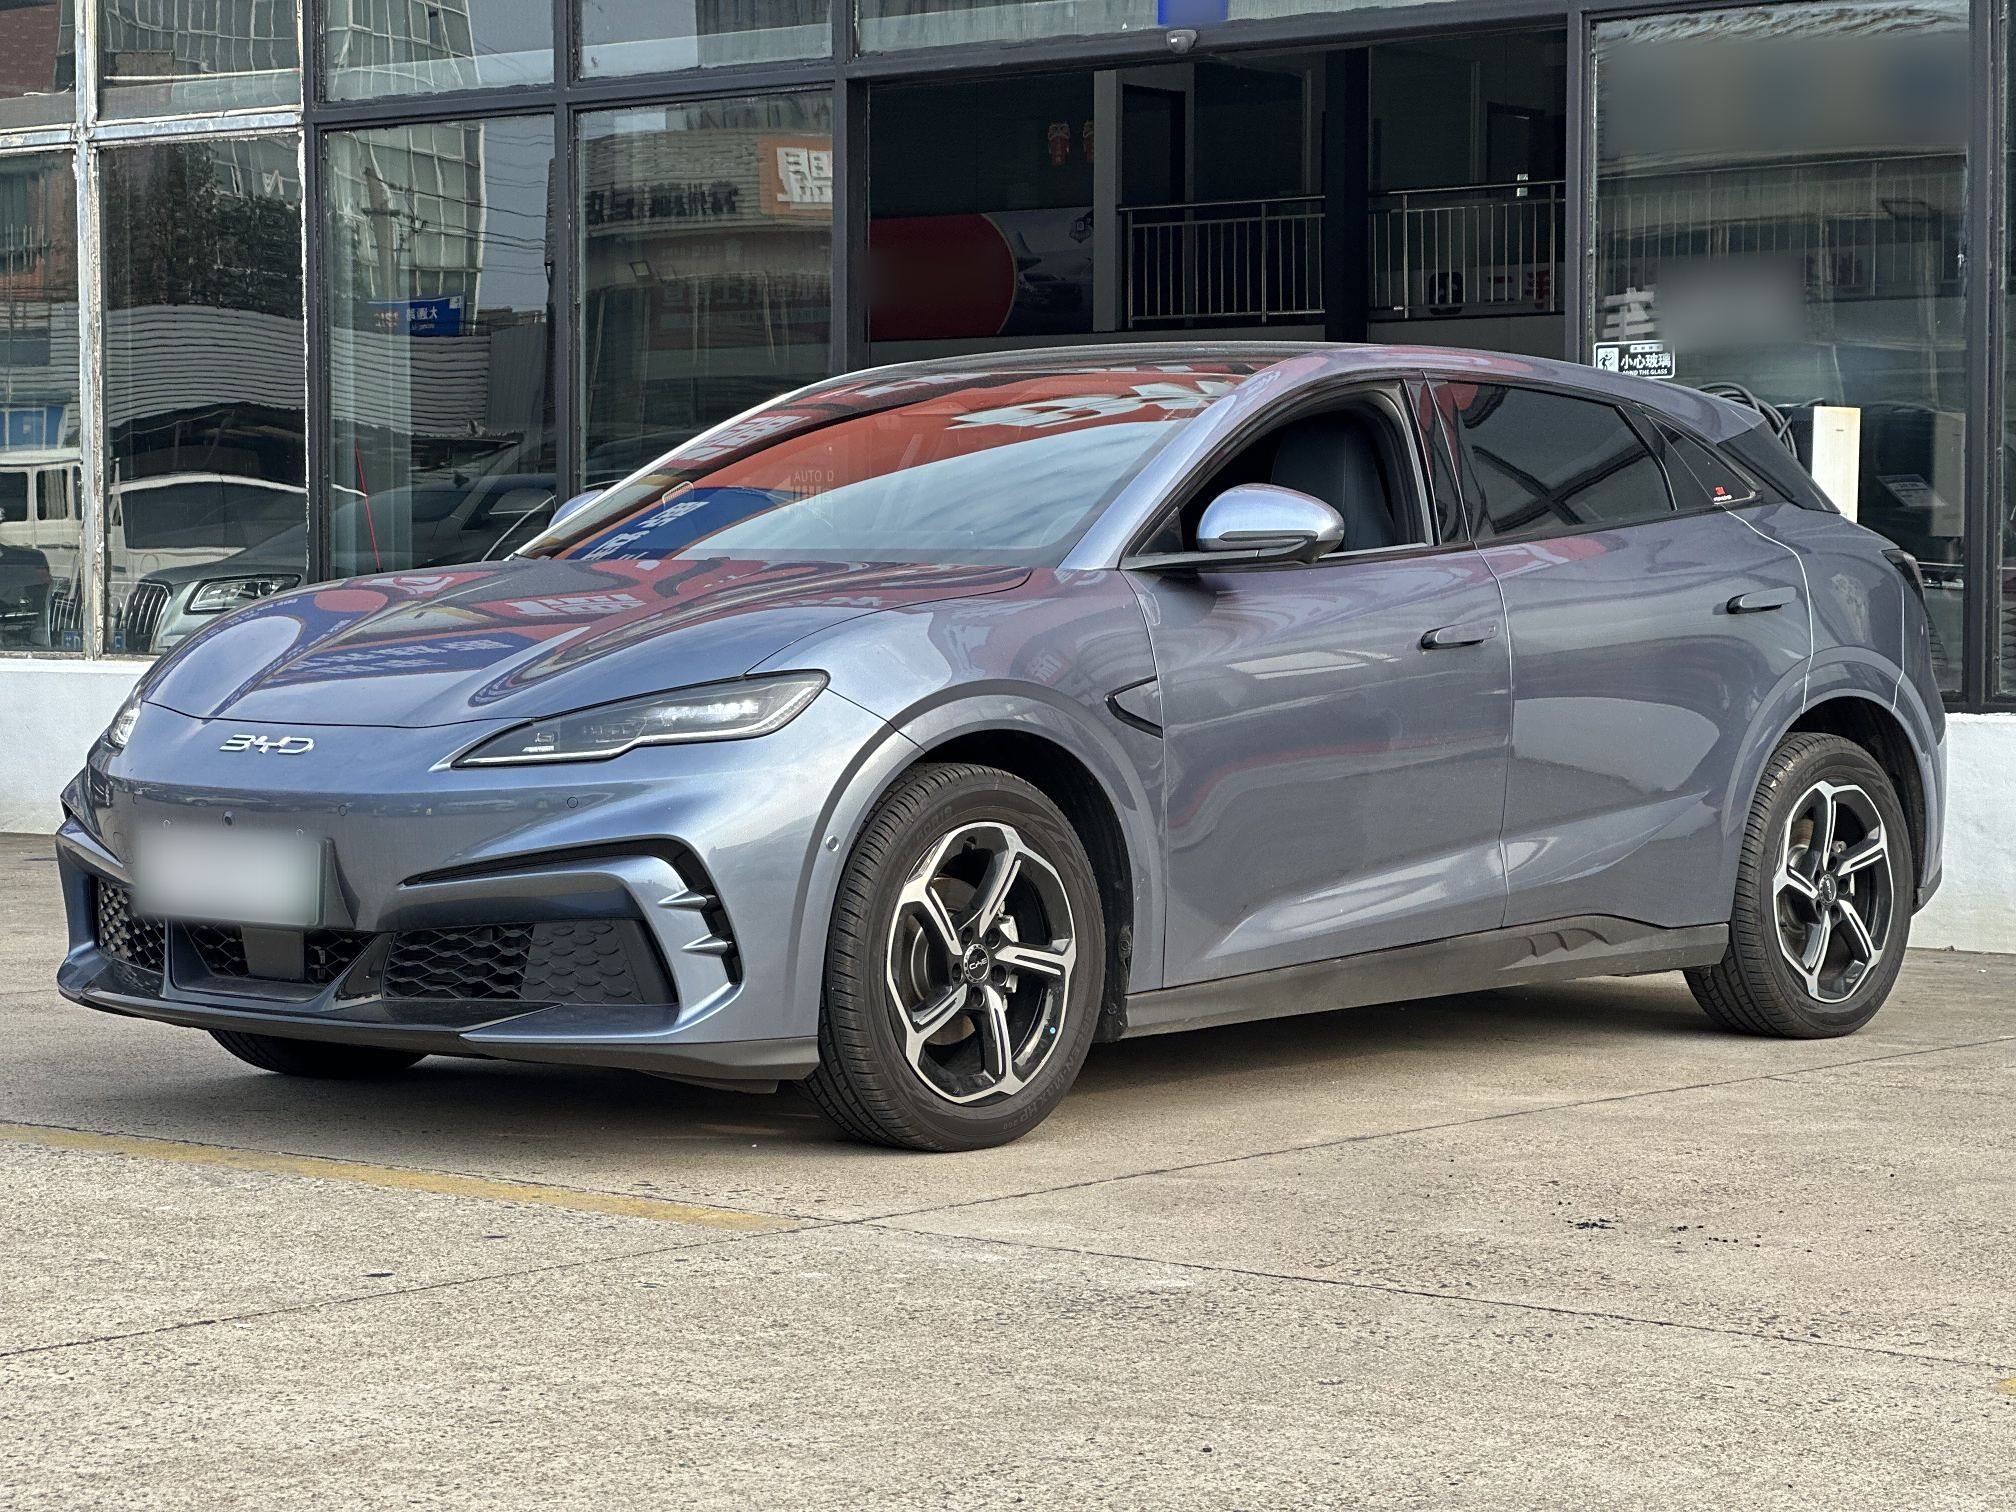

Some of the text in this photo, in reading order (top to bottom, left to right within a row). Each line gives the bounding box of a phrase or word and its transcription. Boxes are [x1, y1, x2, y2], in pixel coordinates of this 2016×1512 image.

[1621, 353, 1671, 369] 小心玻璃
[794, 470, 822, 482] AUTO
[219, 733, 315, 755] BYD
